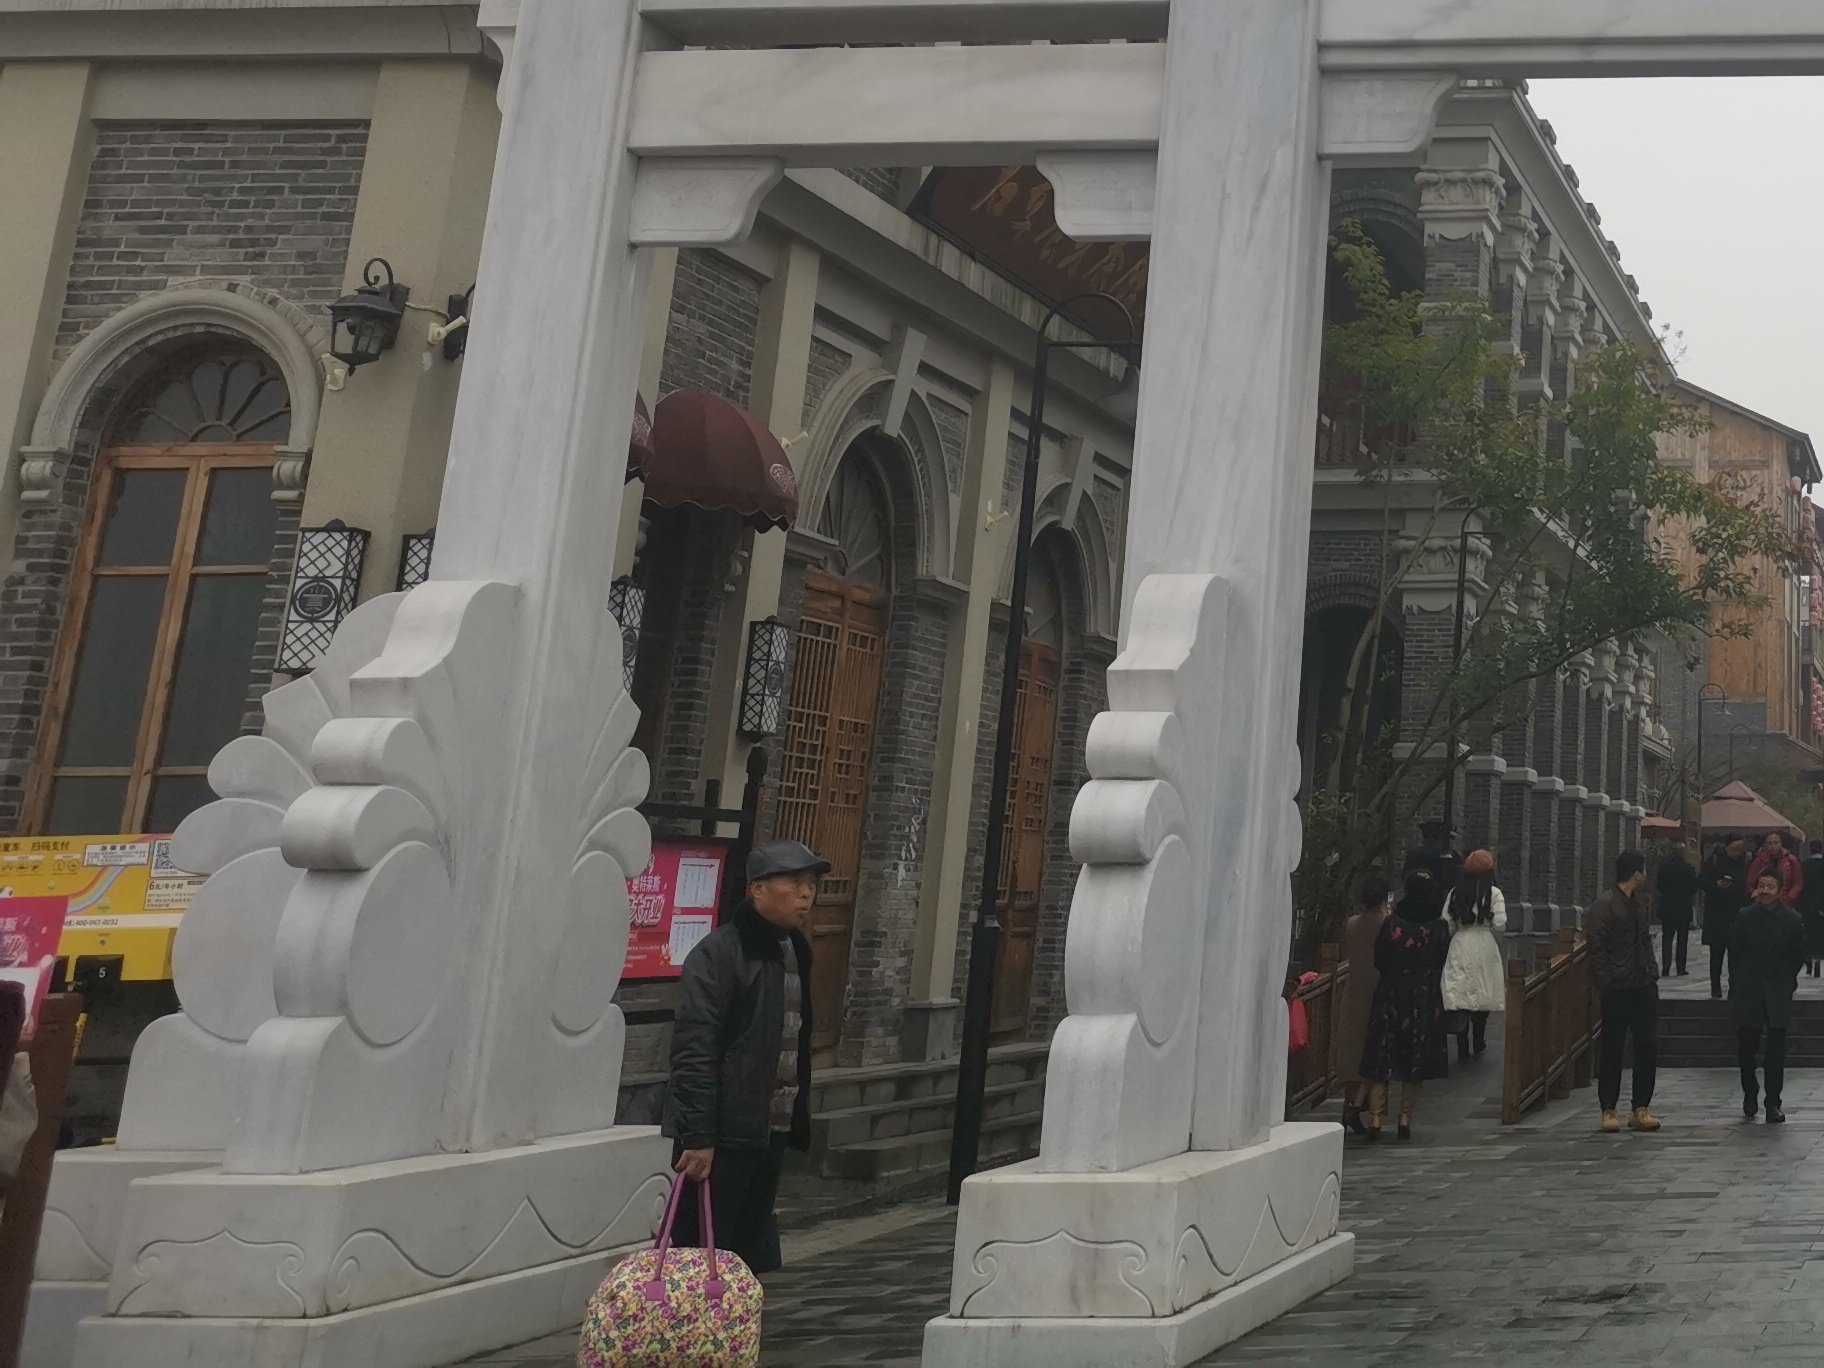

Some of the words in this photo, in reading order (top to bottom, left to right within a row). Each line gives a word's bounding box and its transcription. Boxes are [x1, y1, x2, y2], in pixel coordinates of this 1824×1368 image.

[629, 893, 665, 924] 大开业
[98, 966, 107, 979] 5
